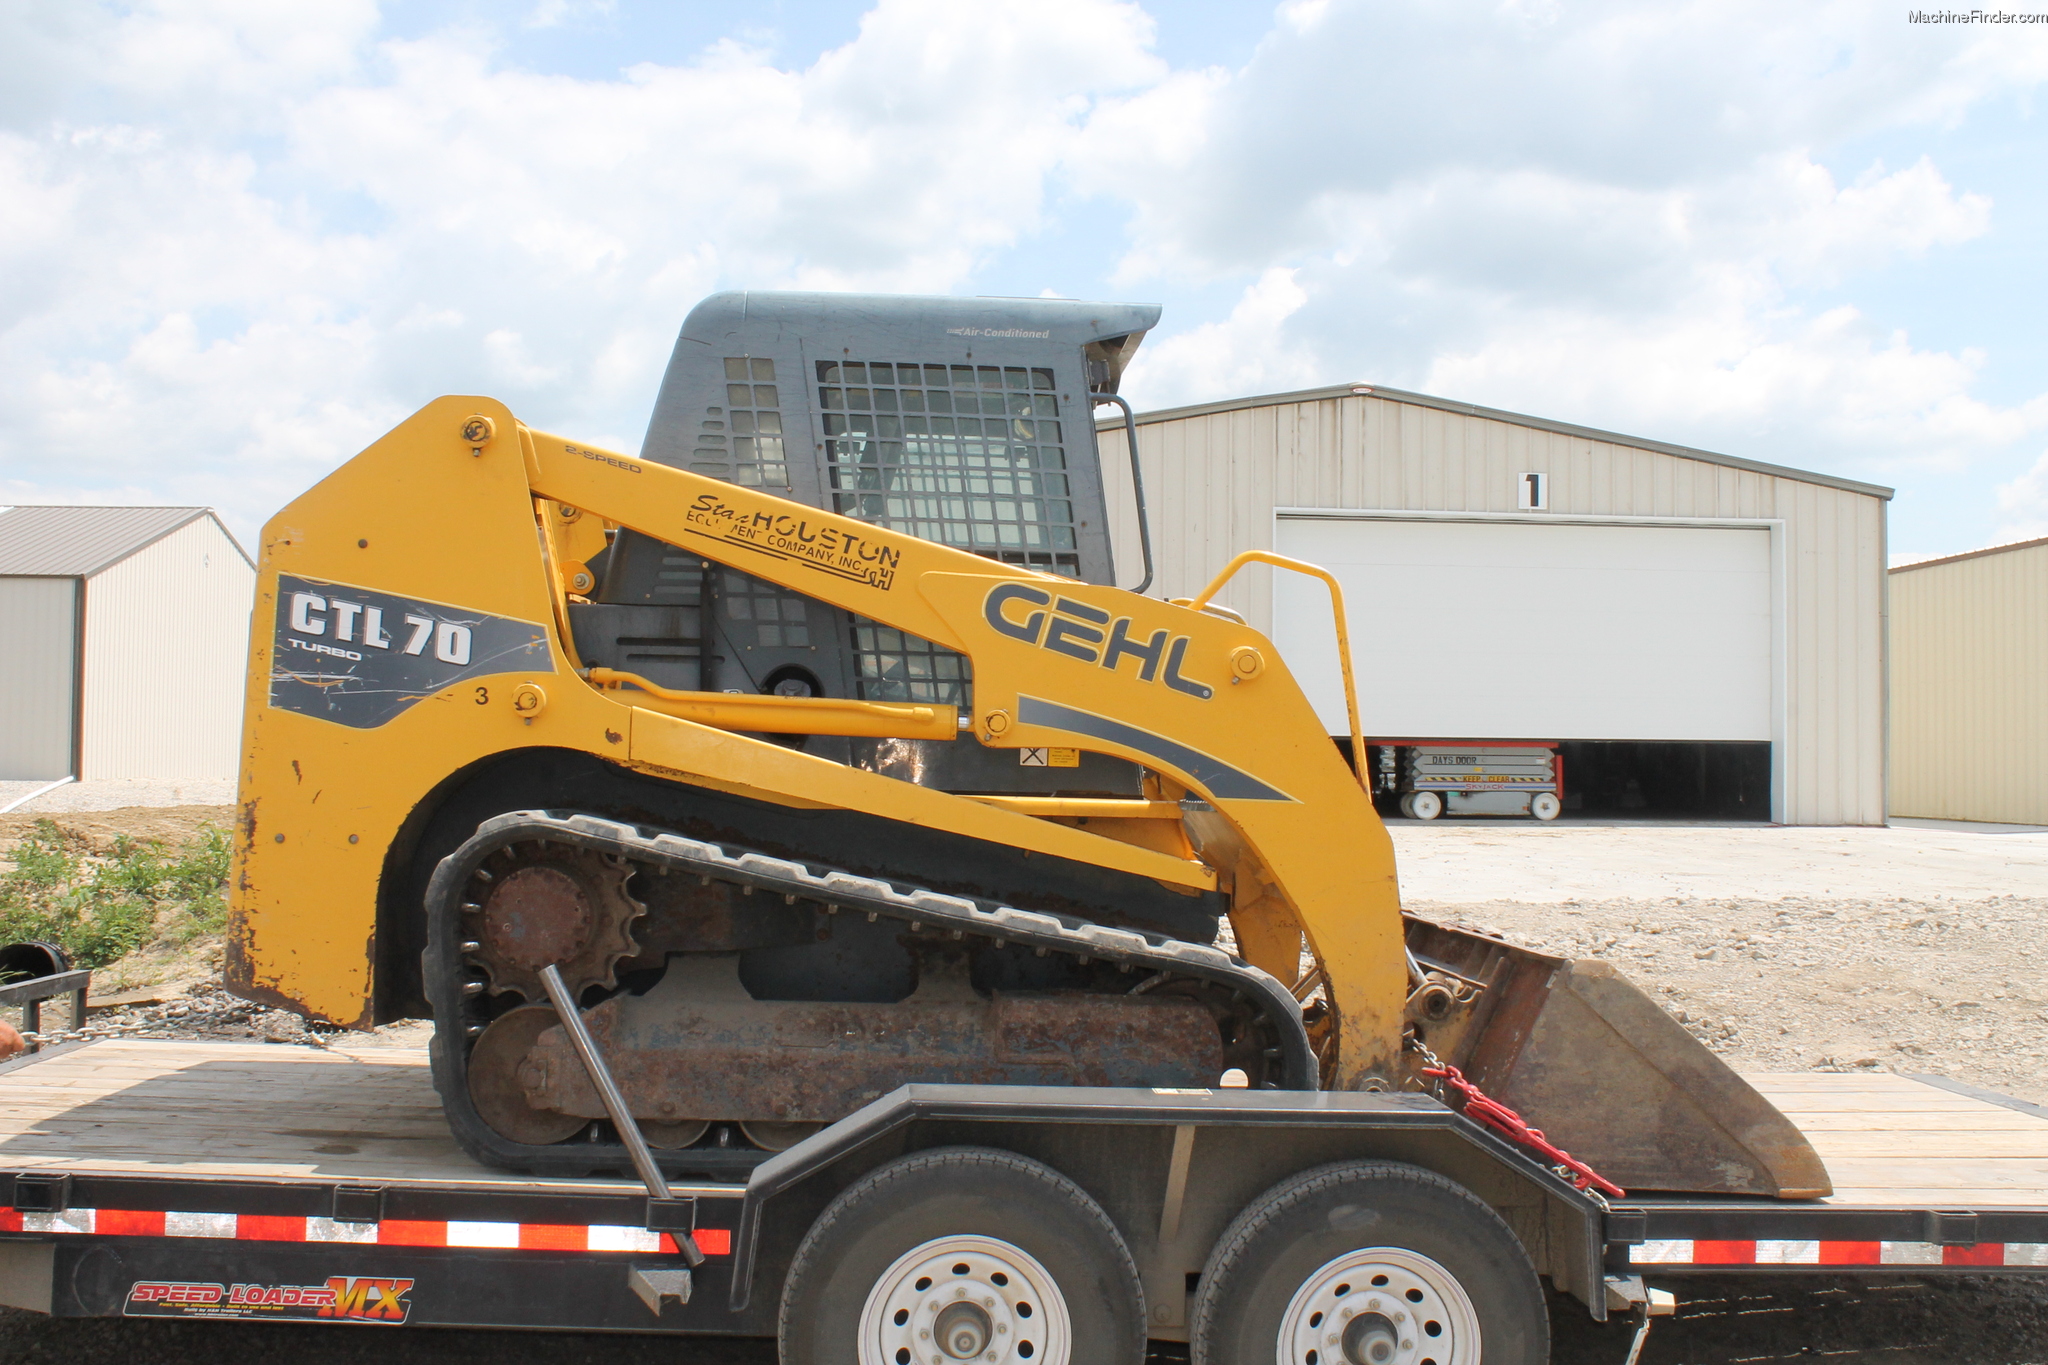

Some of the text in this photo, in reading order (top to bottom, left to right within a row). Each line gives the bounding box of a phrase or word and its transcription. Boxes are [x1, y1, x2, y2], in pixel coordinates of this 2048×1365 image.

[962, 327, 1050, 339] Air-Conditioned
[565, 445, 642, 474] 2-SPEED
[1525, 474, 1539, 507] 1
[752, 511, 901, 569] HOUSTON
[767, 534, 835, 565] COMPANY,
[838, 555, 864, 574] INC.
[290, 591, 473, 666] CTL 70
[982, 579, 1215, 701] GEHL
[288, 638, 362, 662] TURBO
[475, 687, 489, 705] 3
[1432, 757, 1477, 765] DAYS DOOR
[132, 1276, 414, 1319] SPEED LOADER MX
